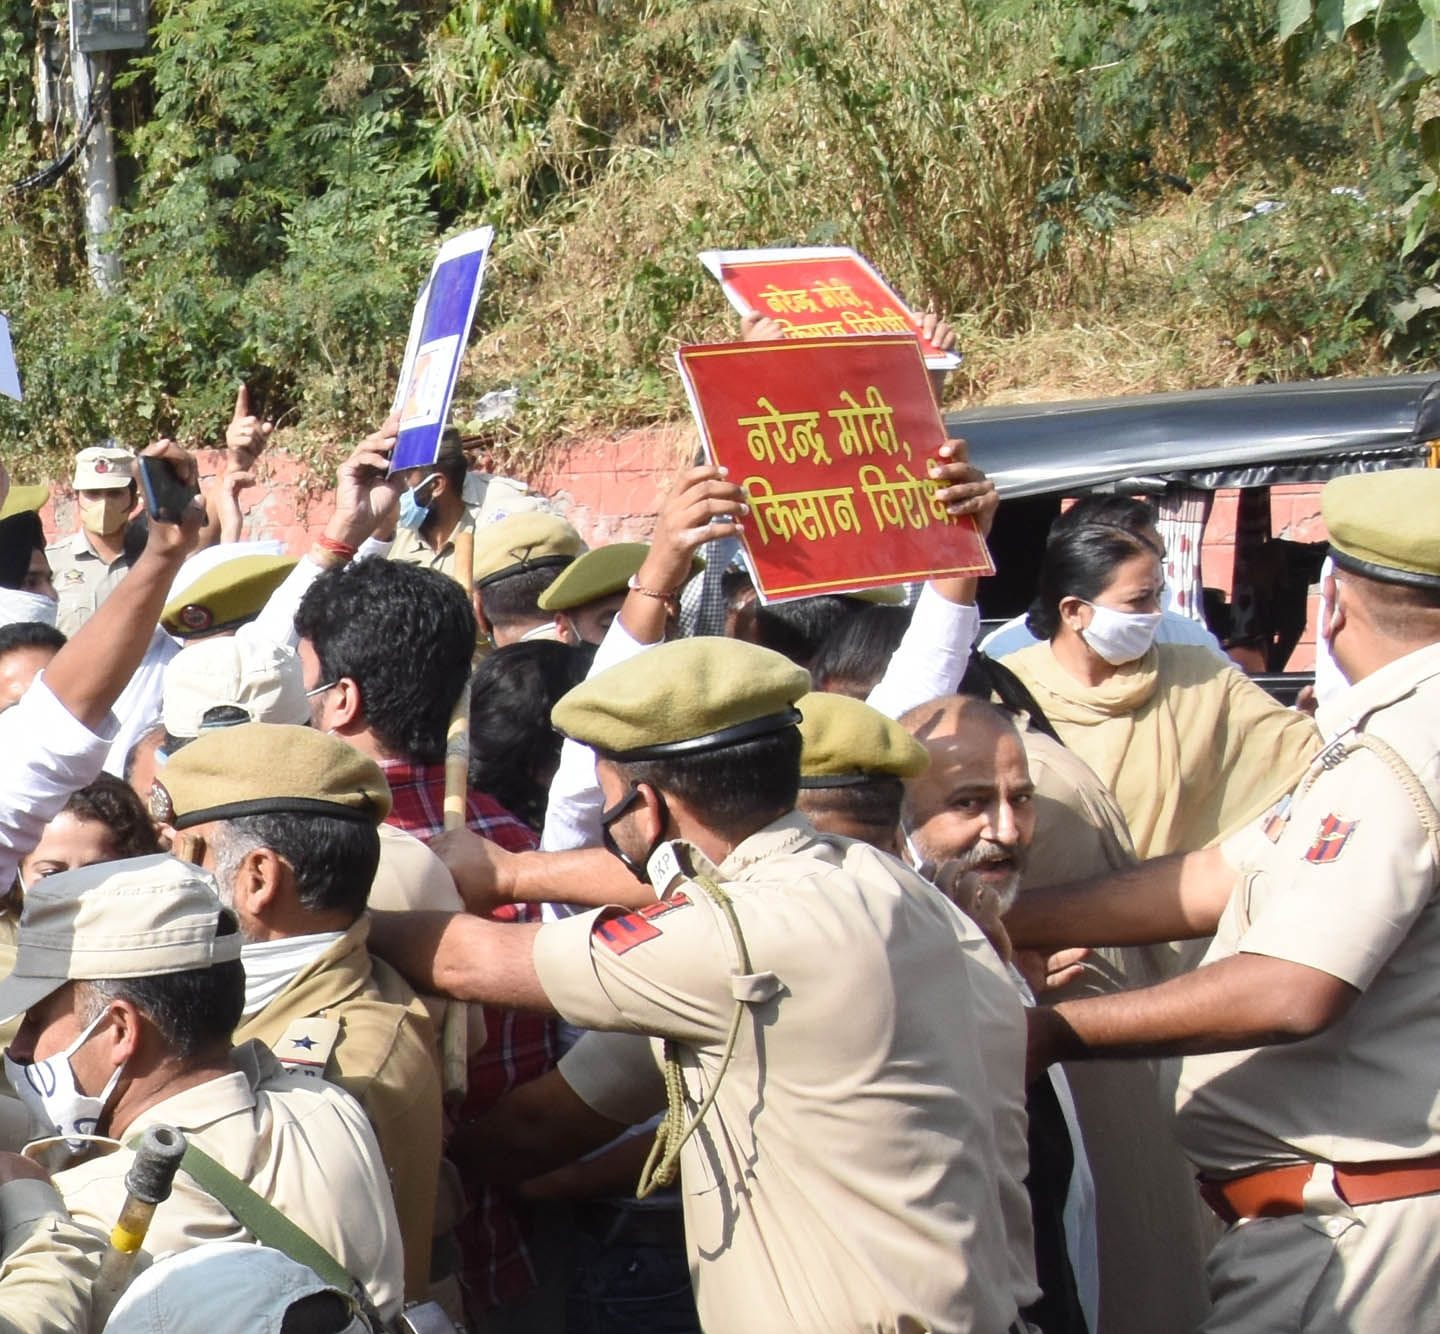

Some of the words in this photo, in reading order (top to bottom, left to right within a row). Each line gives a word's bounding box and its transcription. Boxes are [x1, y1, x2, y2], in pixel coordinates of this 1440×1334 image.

[738, 397, 832, 466] नरेन्द्र
[829, 386, 912, 461] मोदी,
[744, 476, 863, 545] किसान
